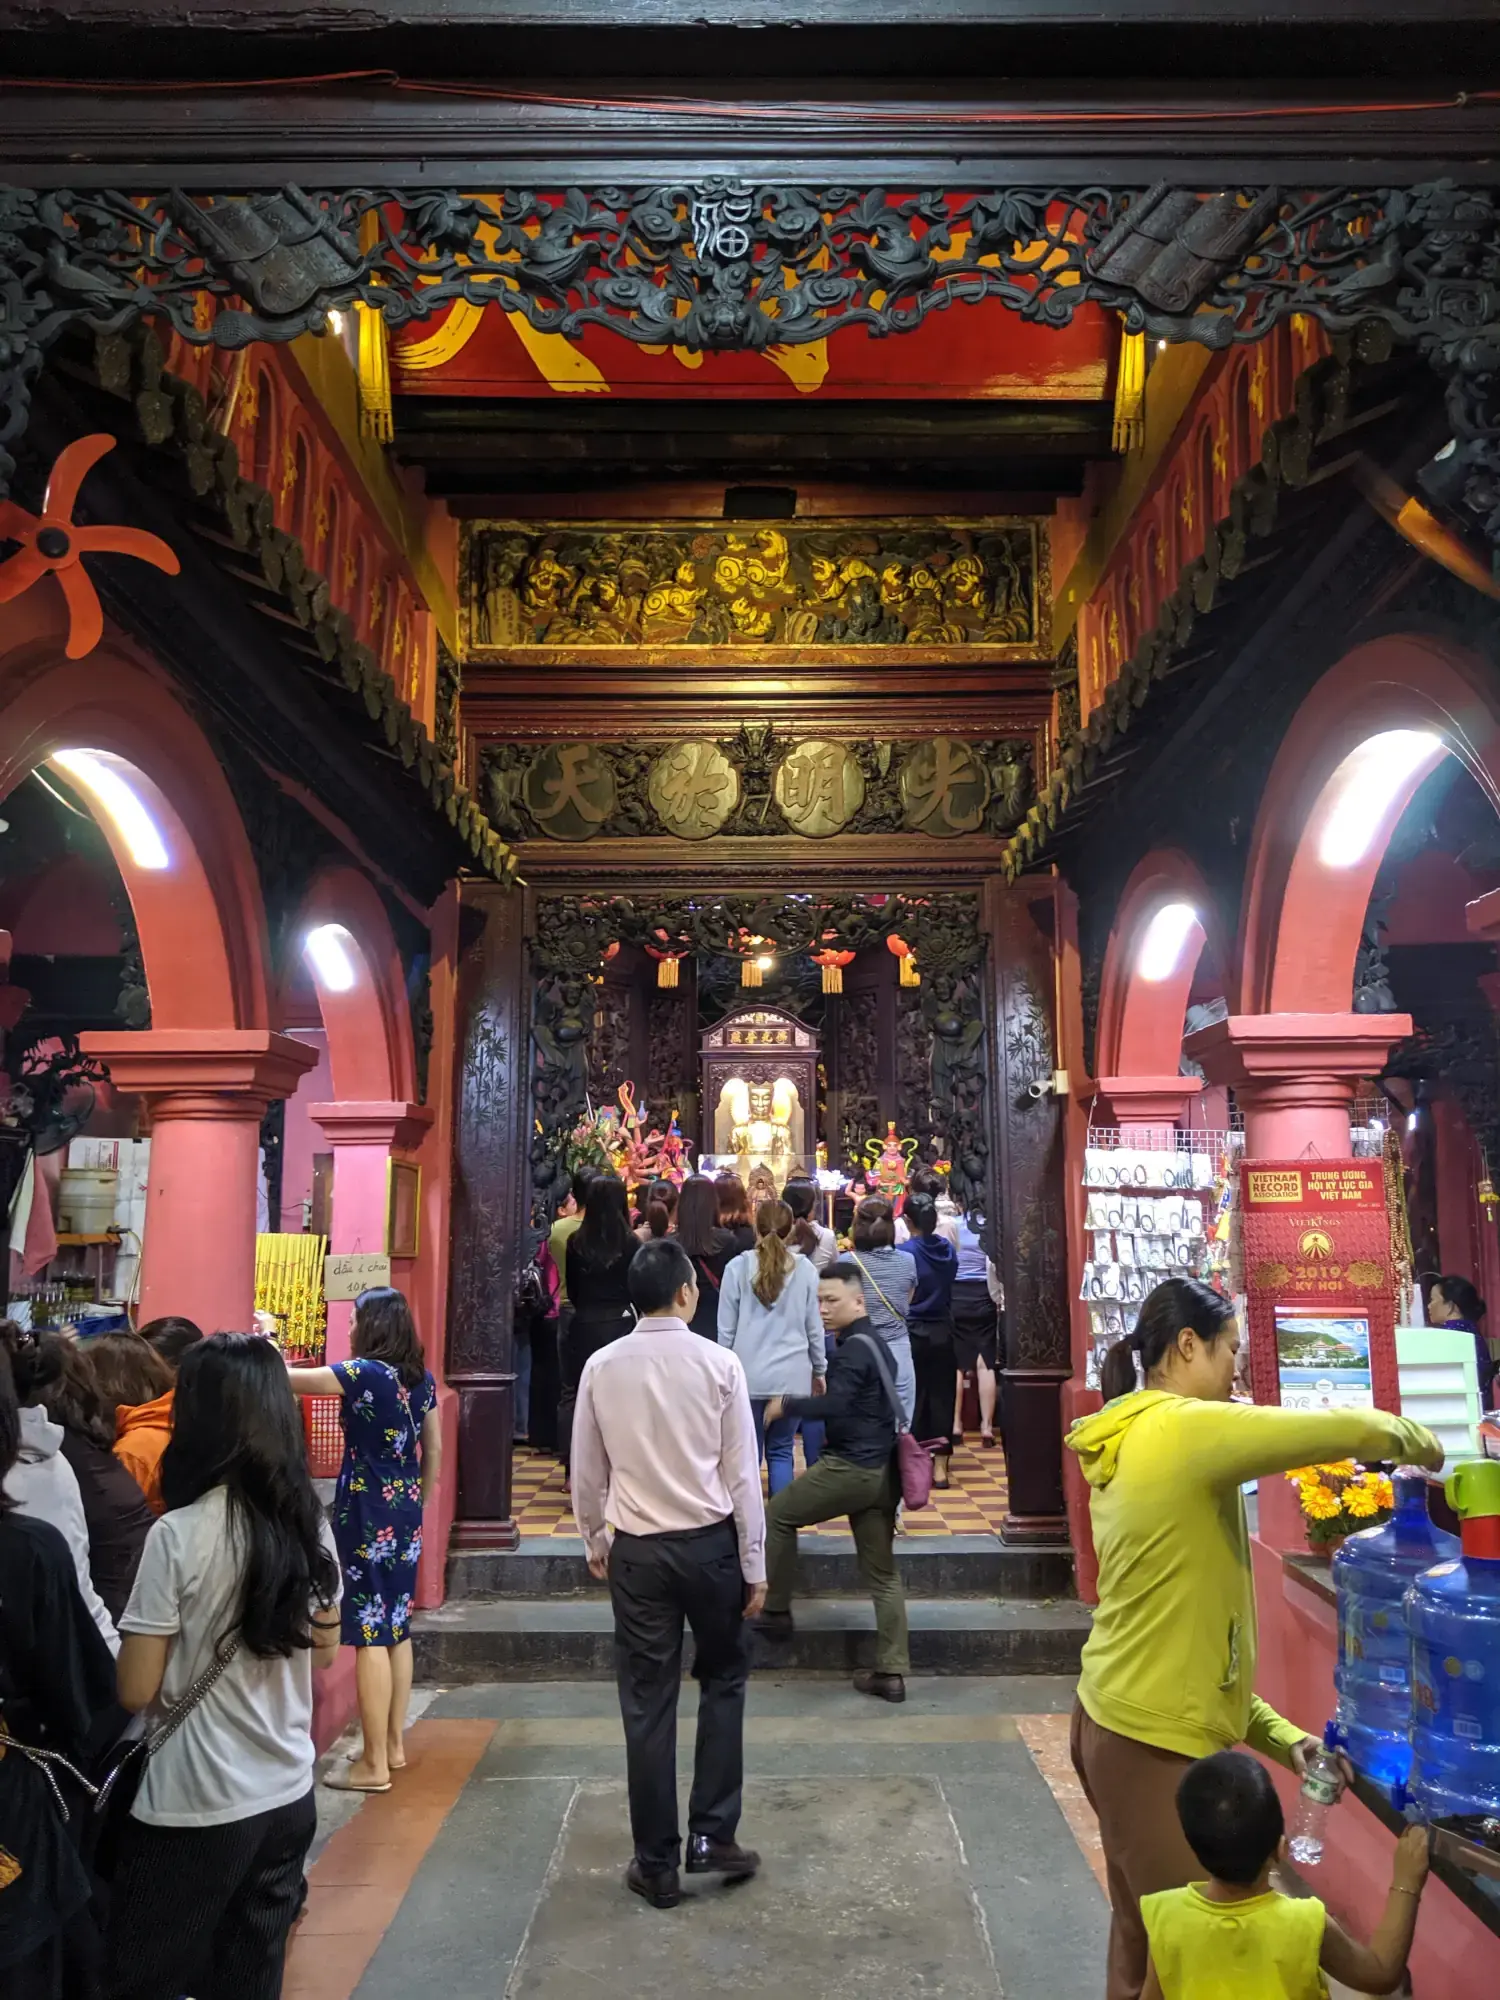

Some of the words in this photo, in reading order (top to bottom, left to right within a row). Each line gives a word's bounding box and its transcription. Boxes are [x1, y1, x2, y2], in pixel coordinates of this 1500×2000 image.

[1253, 1174, 1298, 1183] VIETNAM
[1310, 1171, 1340, 1180] TRUNG
[1342, 1170, 1367, 1180] ƯƠNG
[1253, 1183, 1298, 1192] RECORD
[1358, 1180, 1374, 1190] GIA
[1320, 1189, 1339, 1201] VIỆT
[1342, 1191, 1362, 1200] NAM
[357, 1263, 364, 1273] 1
[1296, 1267, 1342, 1279] 2019
[346, 1282, 367, 1292] 10K
